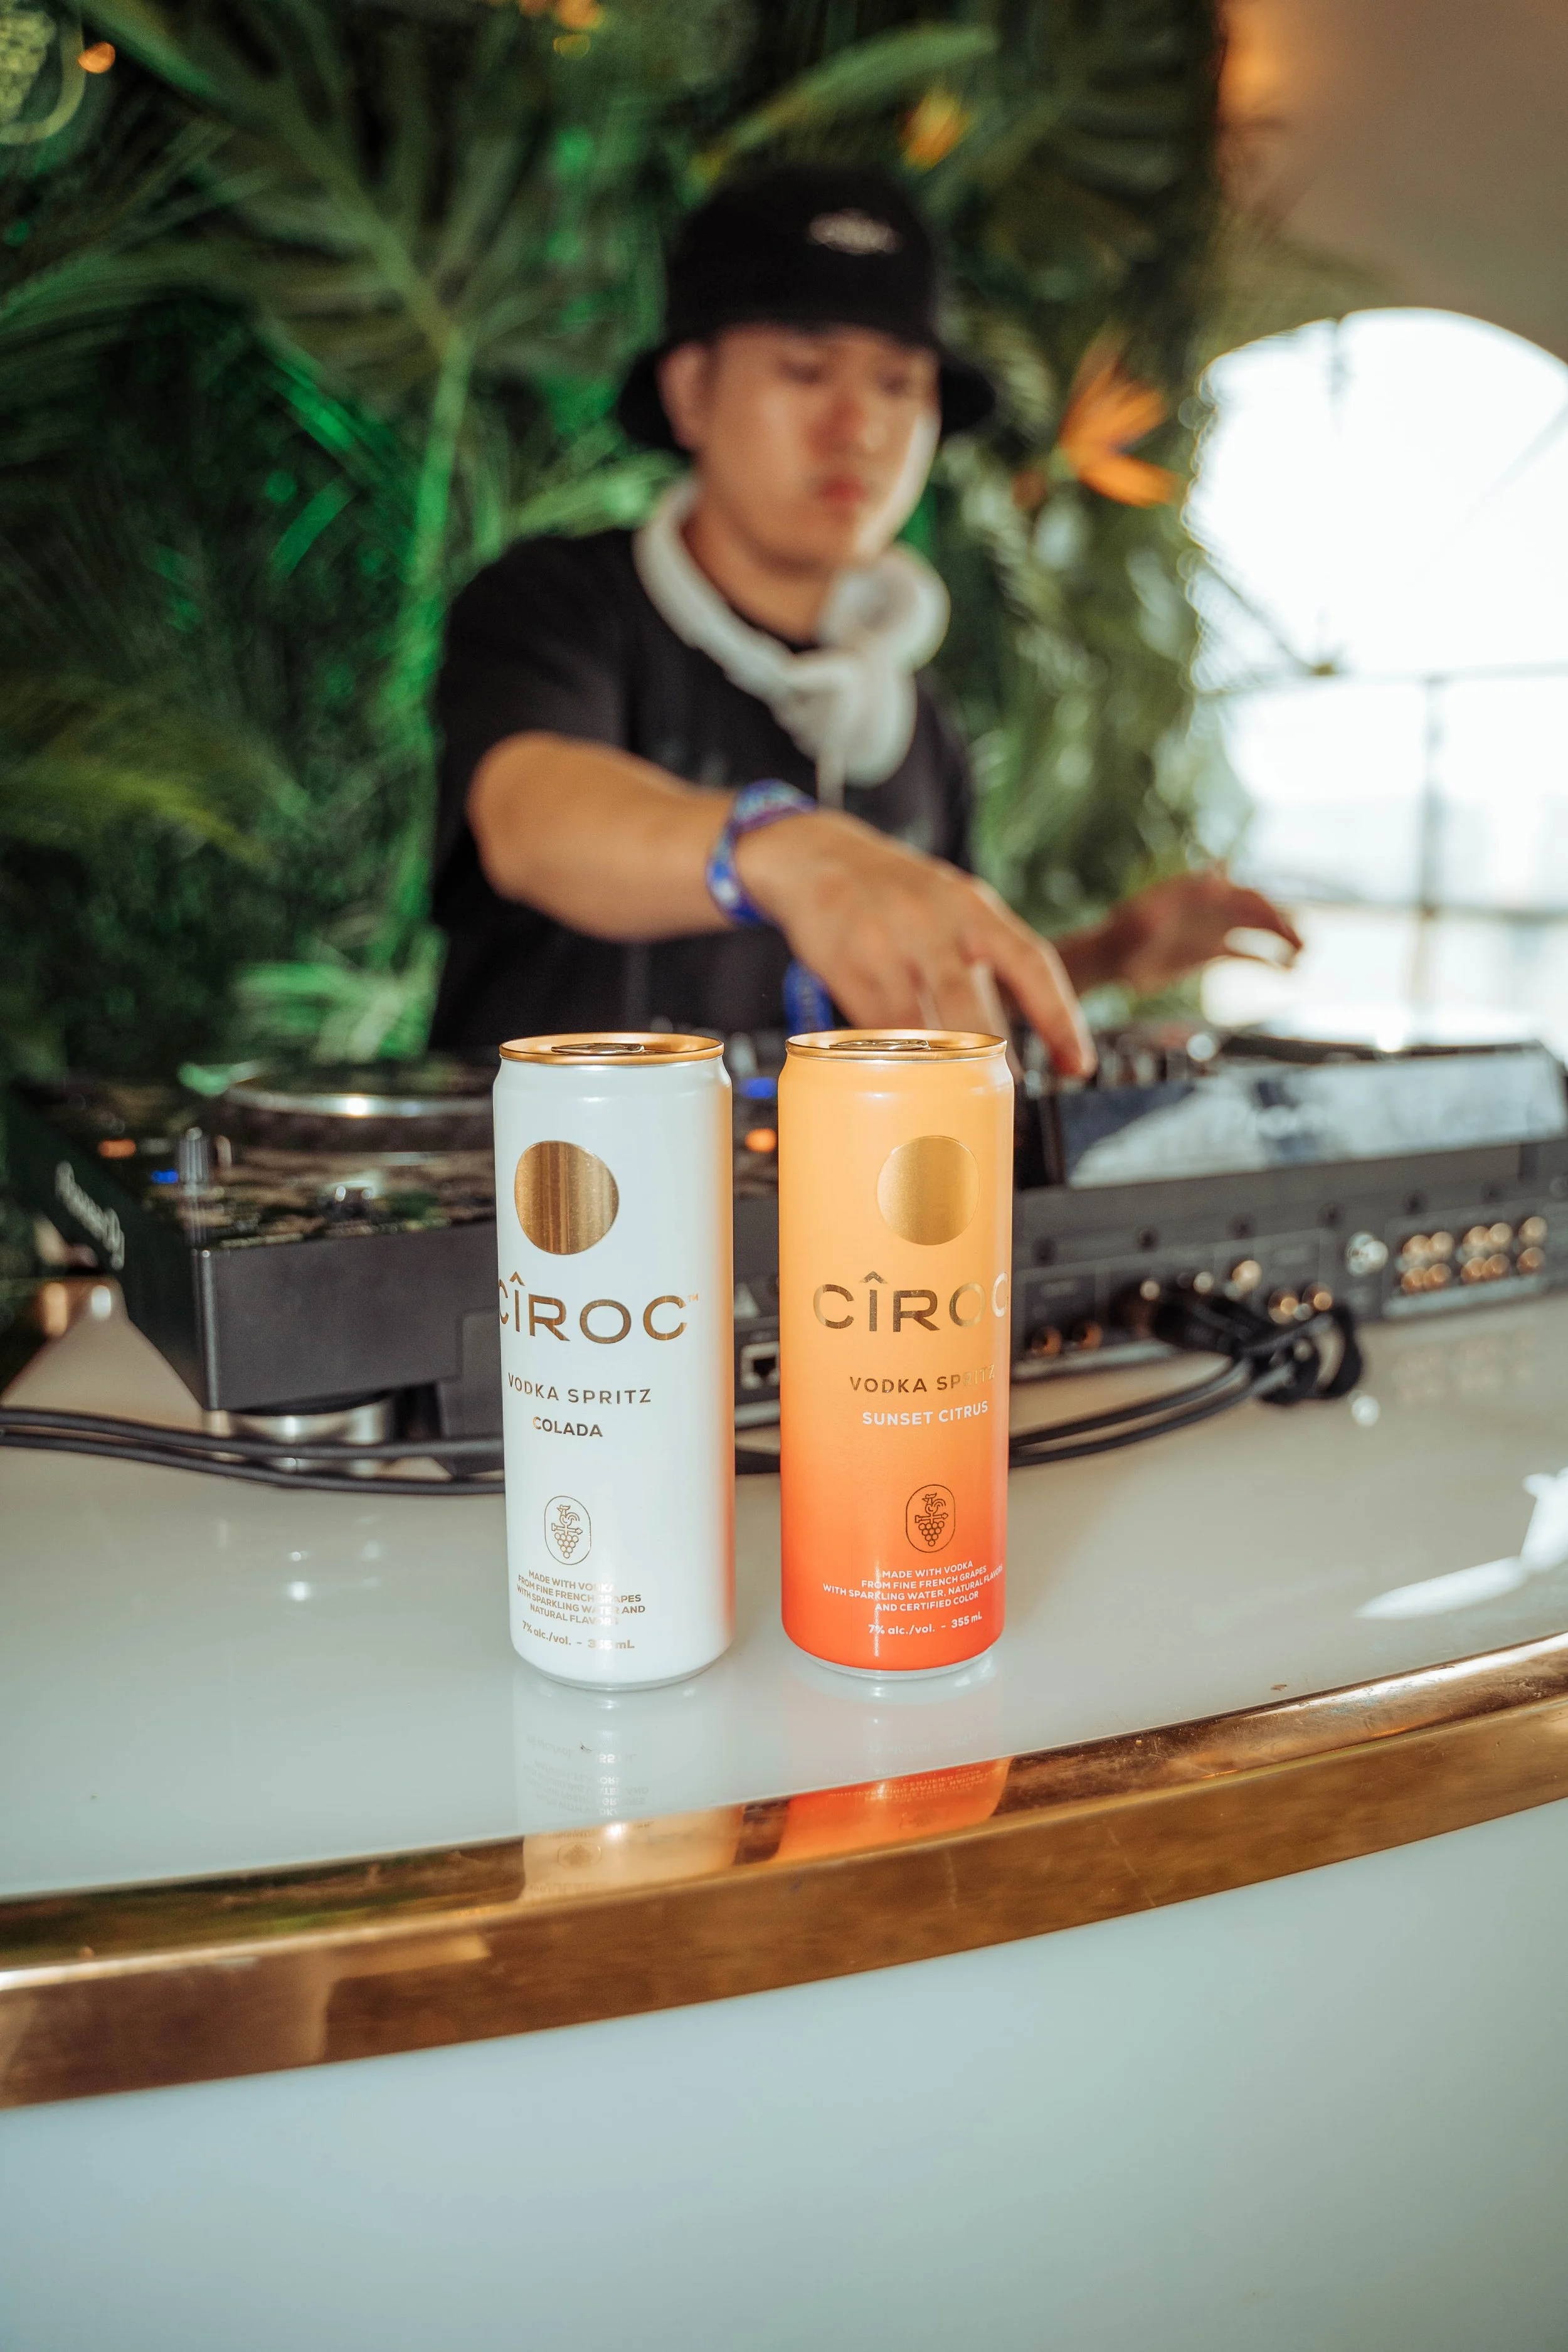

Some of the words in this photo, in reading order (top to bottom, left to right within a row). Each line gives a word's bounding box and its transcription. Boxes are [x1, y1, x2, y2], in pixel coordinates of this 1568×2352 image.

[813, 1271, 1009, 1332] CÎROC
[508, 1372, 559, 1401] VODKA
[568, 1388, 651, 1404] SPRITZ
[849, 1377, 928, 1393] VODKA
[936, 1364, 995, 1391] SPRITZ
[862, 1411, 933, 1426] SUNSET
[938, 1400, 988, 1422] CITRUS
[532, 1416, 603, 1437] COLADA
[529, 1569, 550, 1584] MADE
[552, 1577, 576, 1590] WITH
[861, 1579, 891, 1589] FROM
[893, 1581, 917, 1589] FINE
[919, 1576, 958, 1589] FRENCH
[960, 1565, 987, 1581] GRAPES
[882, 1569, 913, 1579] MADE
[914, 1567, 941, 1578] WITH
[943, 1560, 973, 1574] VODKA
[517, 1583, 531, 1599] WITH
[532, 1593, 580, 1613] SPARKLING
[622, 1605, 645, 1614] AND
[518, 1574, 535, 1590] FROM
[536, 1584, 554, 1597] FINE
[555, 1590, 595, 1603] FRENCH
[823, 1583, 846, 1596] WITH
[849, 1589, 905, 1601] SPARKLING
[908, 1589, 946, 1601] WATER,
[948, 1578, 983, 1595] NATURAL
[530, 1603, 568, 1622] NATURAL
[874, 1603, 898, 1612] AND
[899, 1599, 951, 1611] CERTIFIED
[953, 1590, 979, 1605] COLOR
[522, 1620, 532, 1634] 7%
[534, 1628, 571, 1645] alc./vol.
[615, 1640, 635, 1649] mL
[868, 1624, 885, 1634] 7%
[887, 1624, 935, 1635] alc./vol.
[951, 1616, 970, 1629] 355
[971, 1611, 982, 1622] mL
